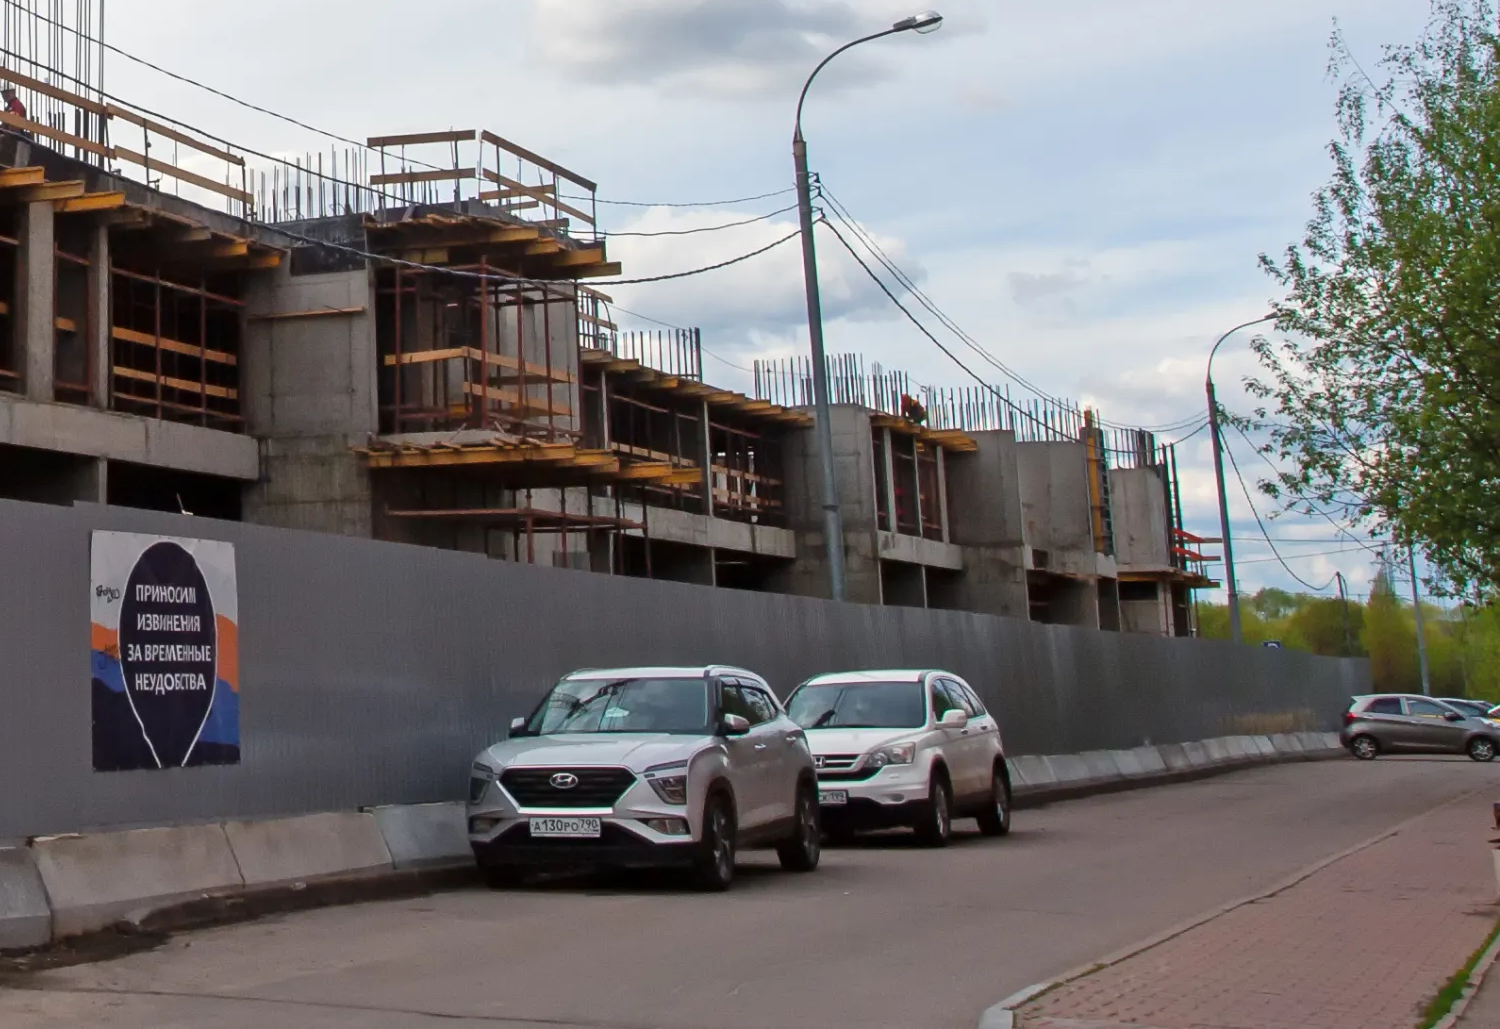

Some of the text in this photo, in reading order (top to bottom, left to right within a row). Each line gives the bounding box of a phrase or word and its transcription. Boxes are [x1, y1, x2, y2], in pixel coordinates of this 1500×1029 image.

[135, 584, 196, 603] ПРИНОСИМ
[137, 613, 200, 632] ИЗВИНЕНИЯ
[127, 644, 142, 661] ЗА
[145, 644, 211, 661] ВРЕМЕННЫЕ
[135, 673, 206, 694] НЕУДОБСТВА
